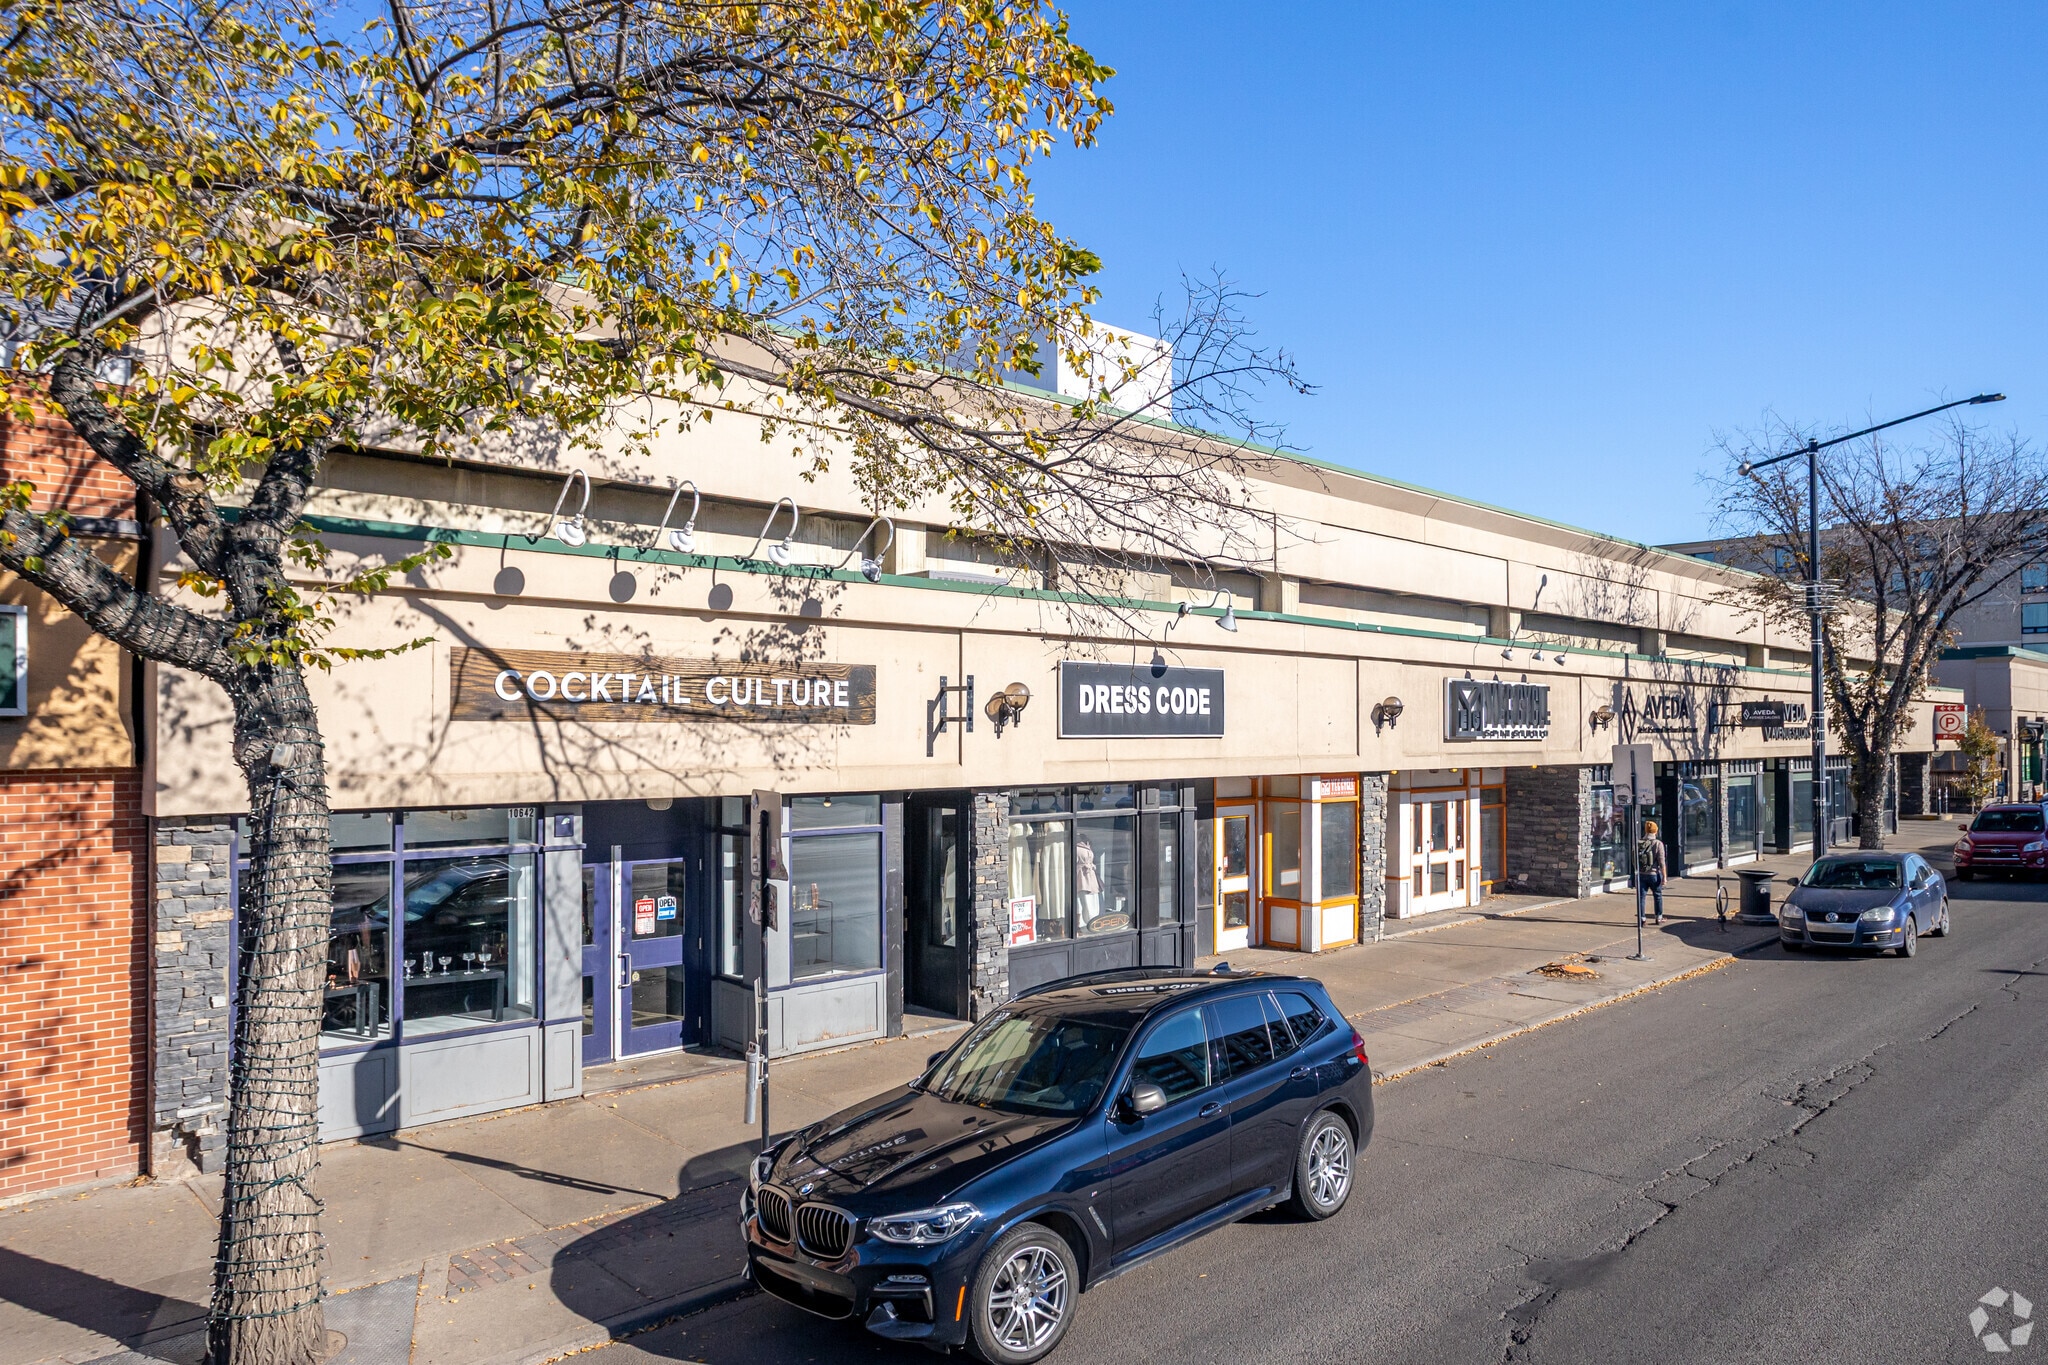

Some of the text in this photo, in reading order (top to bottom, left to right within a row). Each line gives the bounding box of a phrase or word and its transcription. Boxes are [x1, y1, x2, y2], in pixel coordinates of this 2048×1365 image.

[494, 669, 850, 707] COCKTAIL CULTURE
[1079, 684, 1211, 715] DRESS CODE
[1643, 694, 1689, 720] AVEDA
[509, 807, 534, 818] 10642
[659, 898, 676, 907] OPEN
[1094, 916, 1128, 930] OPEN
